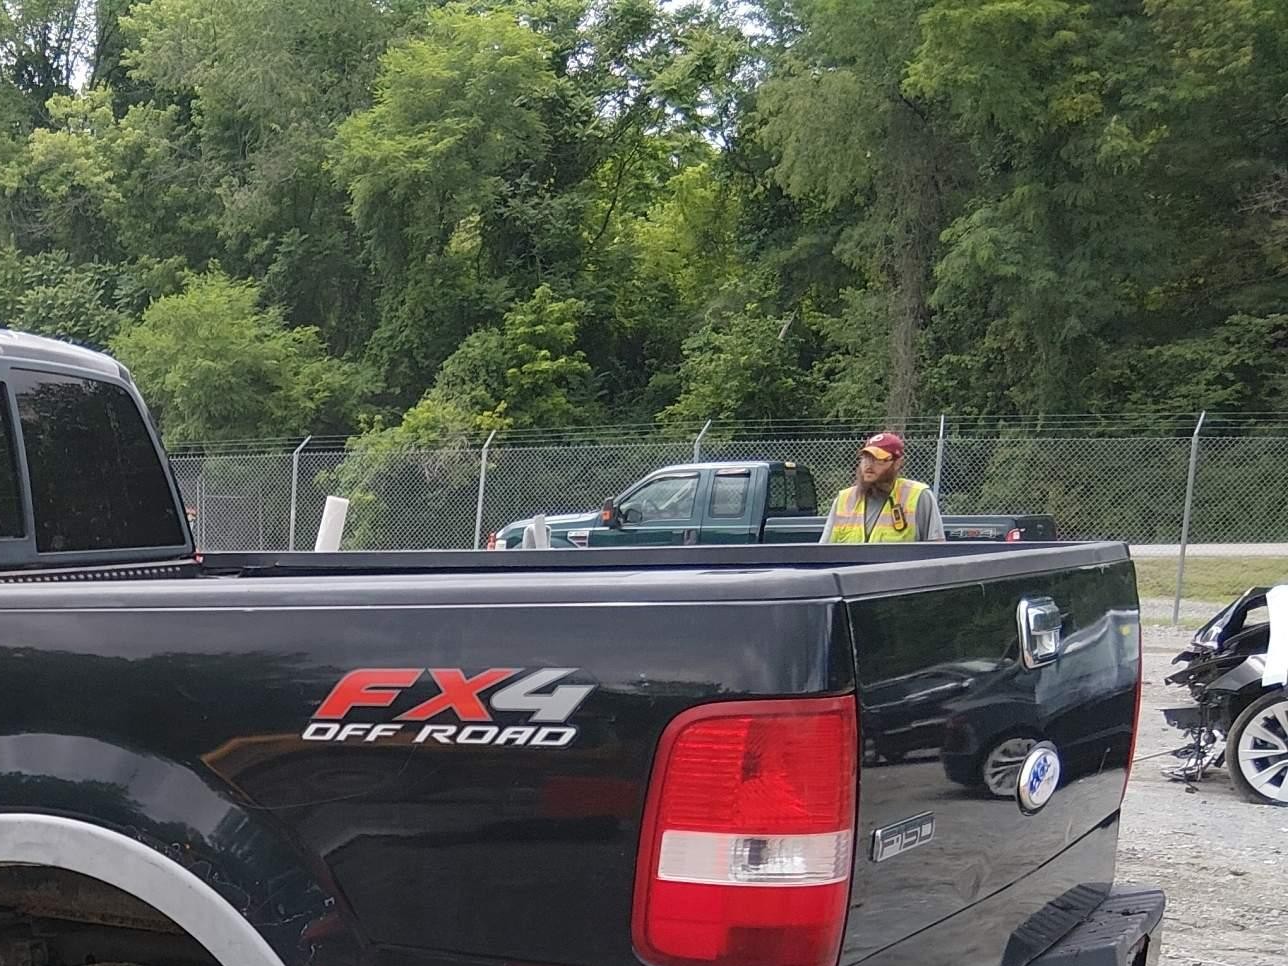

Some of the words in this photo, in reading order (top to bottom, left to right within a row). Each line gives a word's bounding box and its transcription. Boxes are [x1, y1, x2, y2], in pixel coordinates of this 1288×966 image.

[311, 667, 599, 723] FX4
[301, 722, 405, 742] OFF
[411, 723, 578, 747] ROAD
